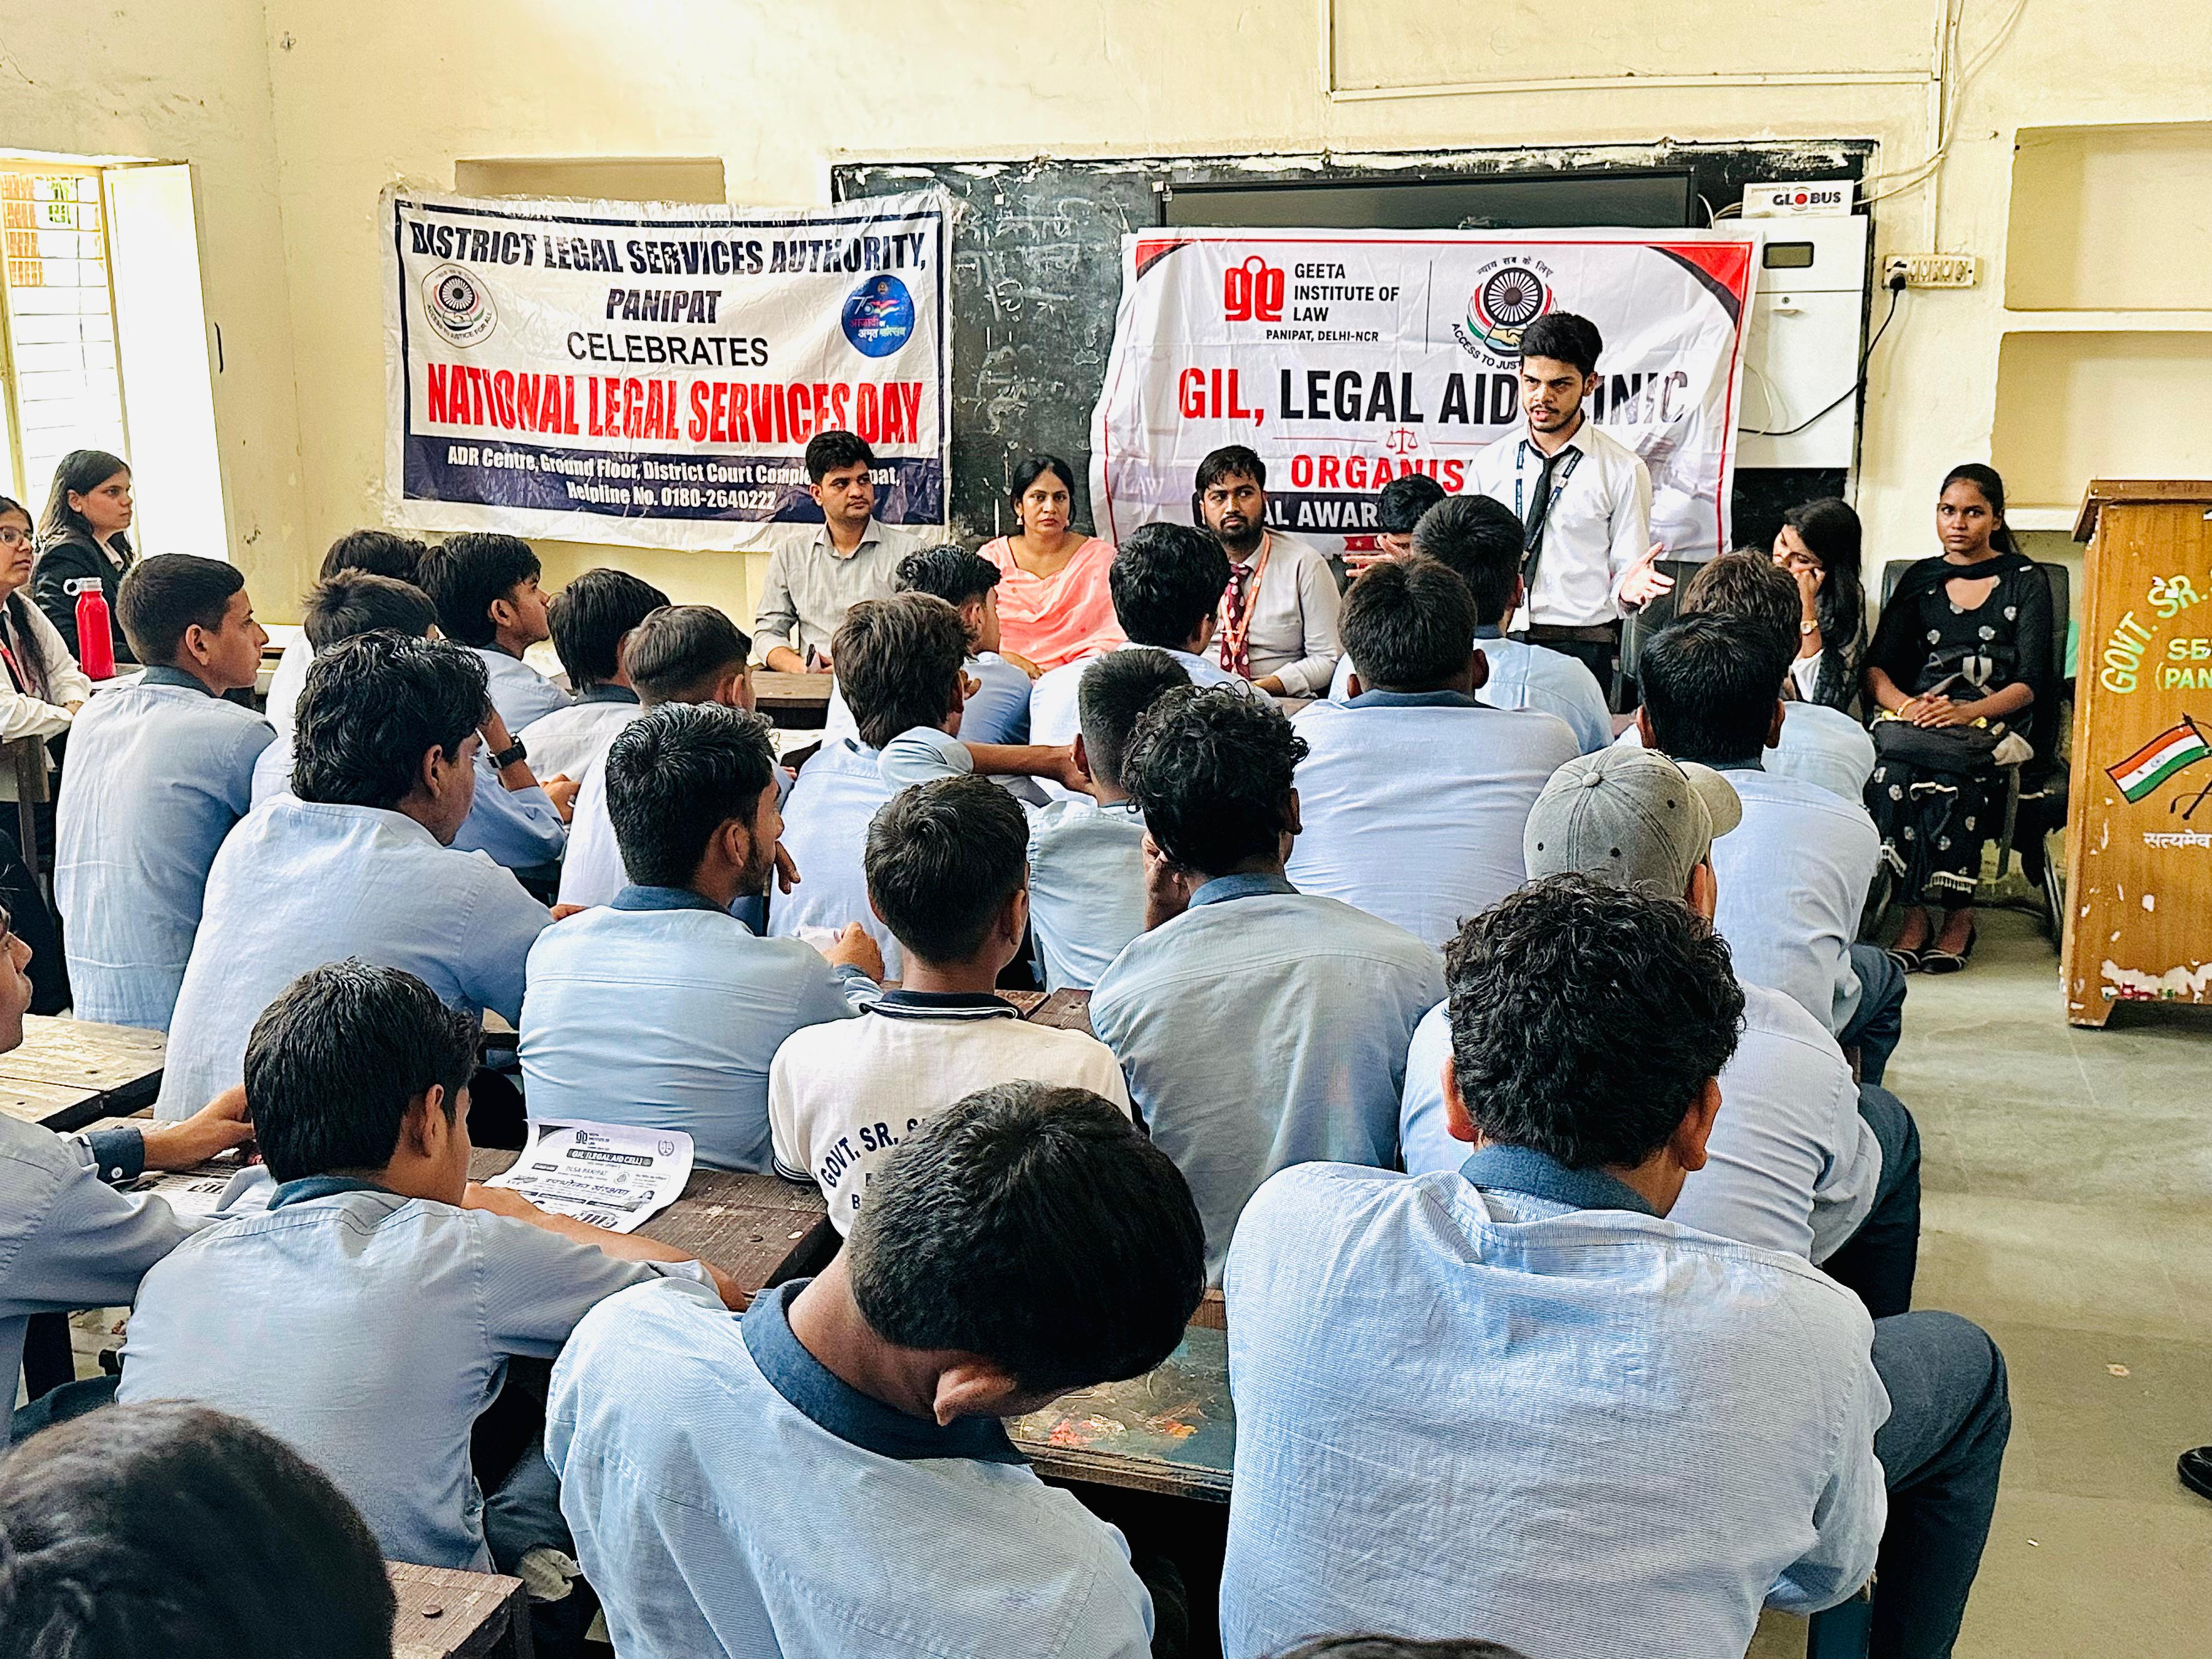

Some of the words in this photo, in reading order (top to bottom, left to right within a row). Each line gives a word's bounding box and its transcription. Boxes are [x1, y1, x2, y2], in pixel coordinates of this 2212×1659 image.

[1773, 191, 1841, 206] GLOBUS
[409, 221, 537, 266] DISTRICT
[544, 235, 624, 273] LEGAL
[627, 239, 764, 275] SERVICES
[769, 233, 926, 273] AUTHORITY,
[1294, 263, 1346, 279] GEETA
[606, 288, 723, 324] PANIPAT
[1294, 286, 1374, 301] INSTITUTE
[1379, 286, 1400, 301] OF
[1293, 307, 1329, 321] LAW
[567, 331, 768, 366] CELEBRATES
[1266, 330, 1314, 342] PANIPAT,
[1318, 330, 1379, 342] DELHI-NCR
[1452, 324, 1481, 359] ACCESS
[1482, 354, 1496, 366] TO
[428, 363, 579, 435] NATIONAL
[589, 376, 679, 439] LEGAL
[689, 380, 850, 444] SERVICES
[857, 382, 923, 444] DAY
[1178, 367, 1265, 427] GIL,
[1280, 369, 1424, 424] LEGAL
[1438, 373, 1519, 425] AID
[1593, 370, 1688, 425] INIC
[448, 445, 479, 466] ADR
[482, 450, 540, 473] Centre,
[540, 453, 594, 477] Ground
[597, 459, 641, 481] Floor,
[644, 461, 705, 482] District
[707, 463, 754, 483] Court
[755, 465, 812, 487] Comple
[566, 481, 630, 504] Helpline
[633, 486, 658, 506] No.
[661, 487, 777, 510] 0180-2640222
[2100, 610, 2159, 694] GOVT.
[821, 1137, 861, 1188] GOVT.
[859, 1122, 899, 1152] SR.
